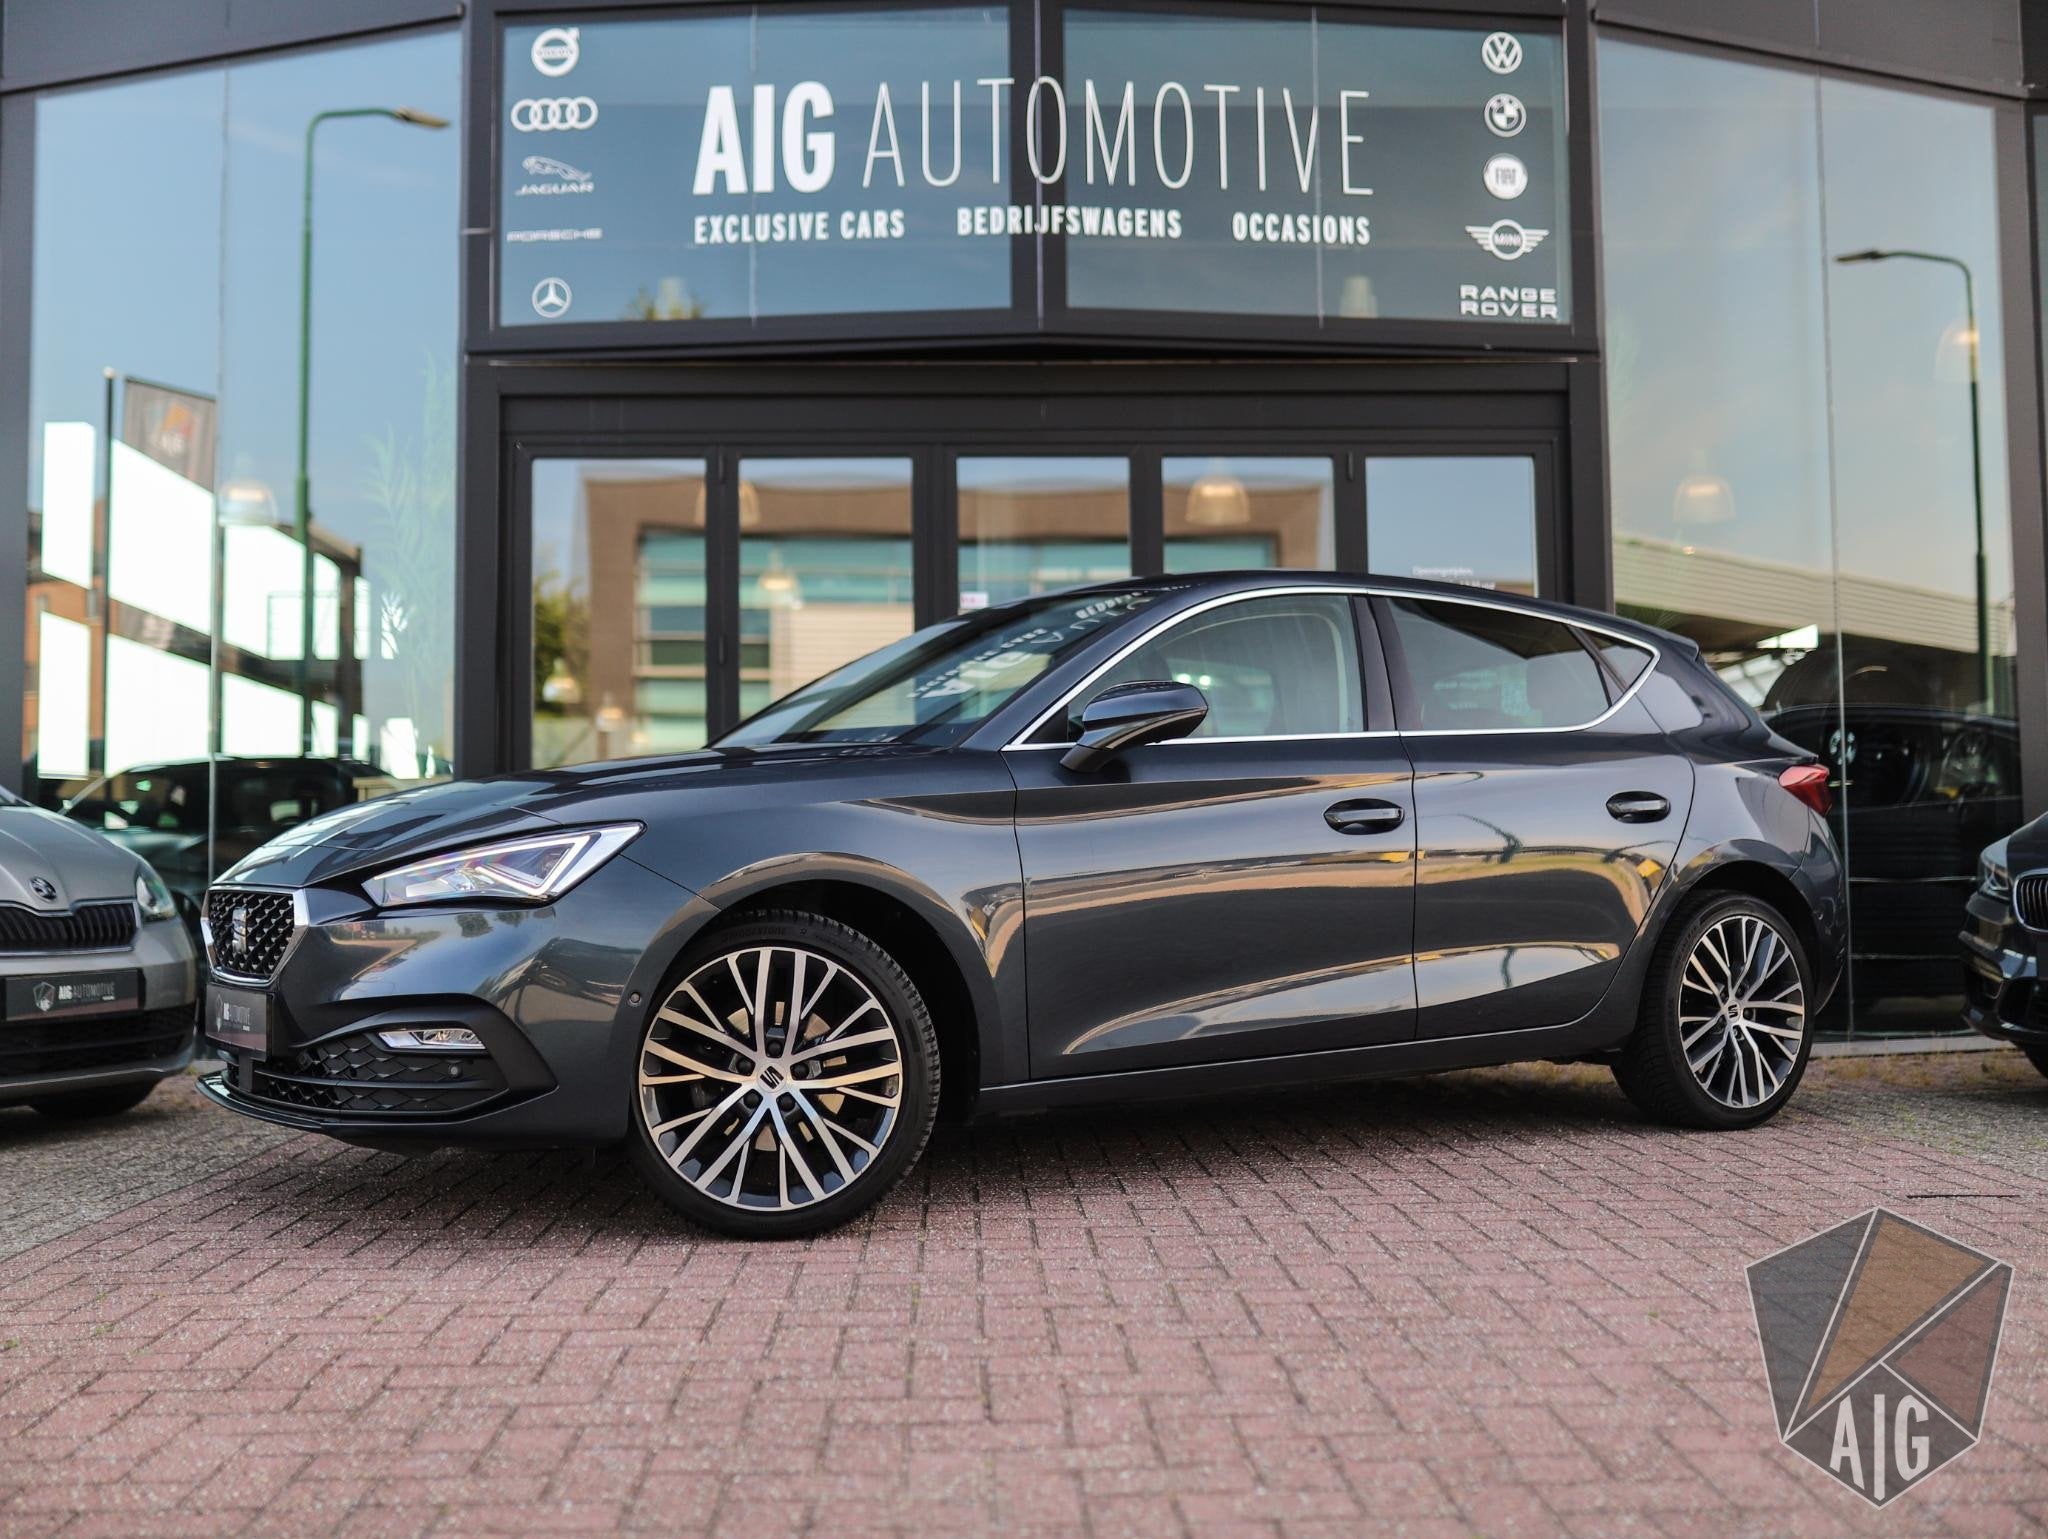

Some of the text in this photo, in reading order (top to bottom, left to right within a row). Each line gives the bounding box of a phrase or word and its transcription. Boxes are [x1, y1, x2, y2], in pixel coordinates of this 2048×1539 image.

[693, 76, 1374, 195] AIG AUTOMOTIVE
[514, 182, 594, 196] JAGUAR
[694, 209, 905, 244] EXCLUSIVE CARS
[957, 205, 1182, 239] BEDRIJFSWAGENS
[1232, 211, 1371, 245] OCCASIONS
[1460, 284, 1556, 302] RANGE
[1460, 300, 1557, 319] ROVER
